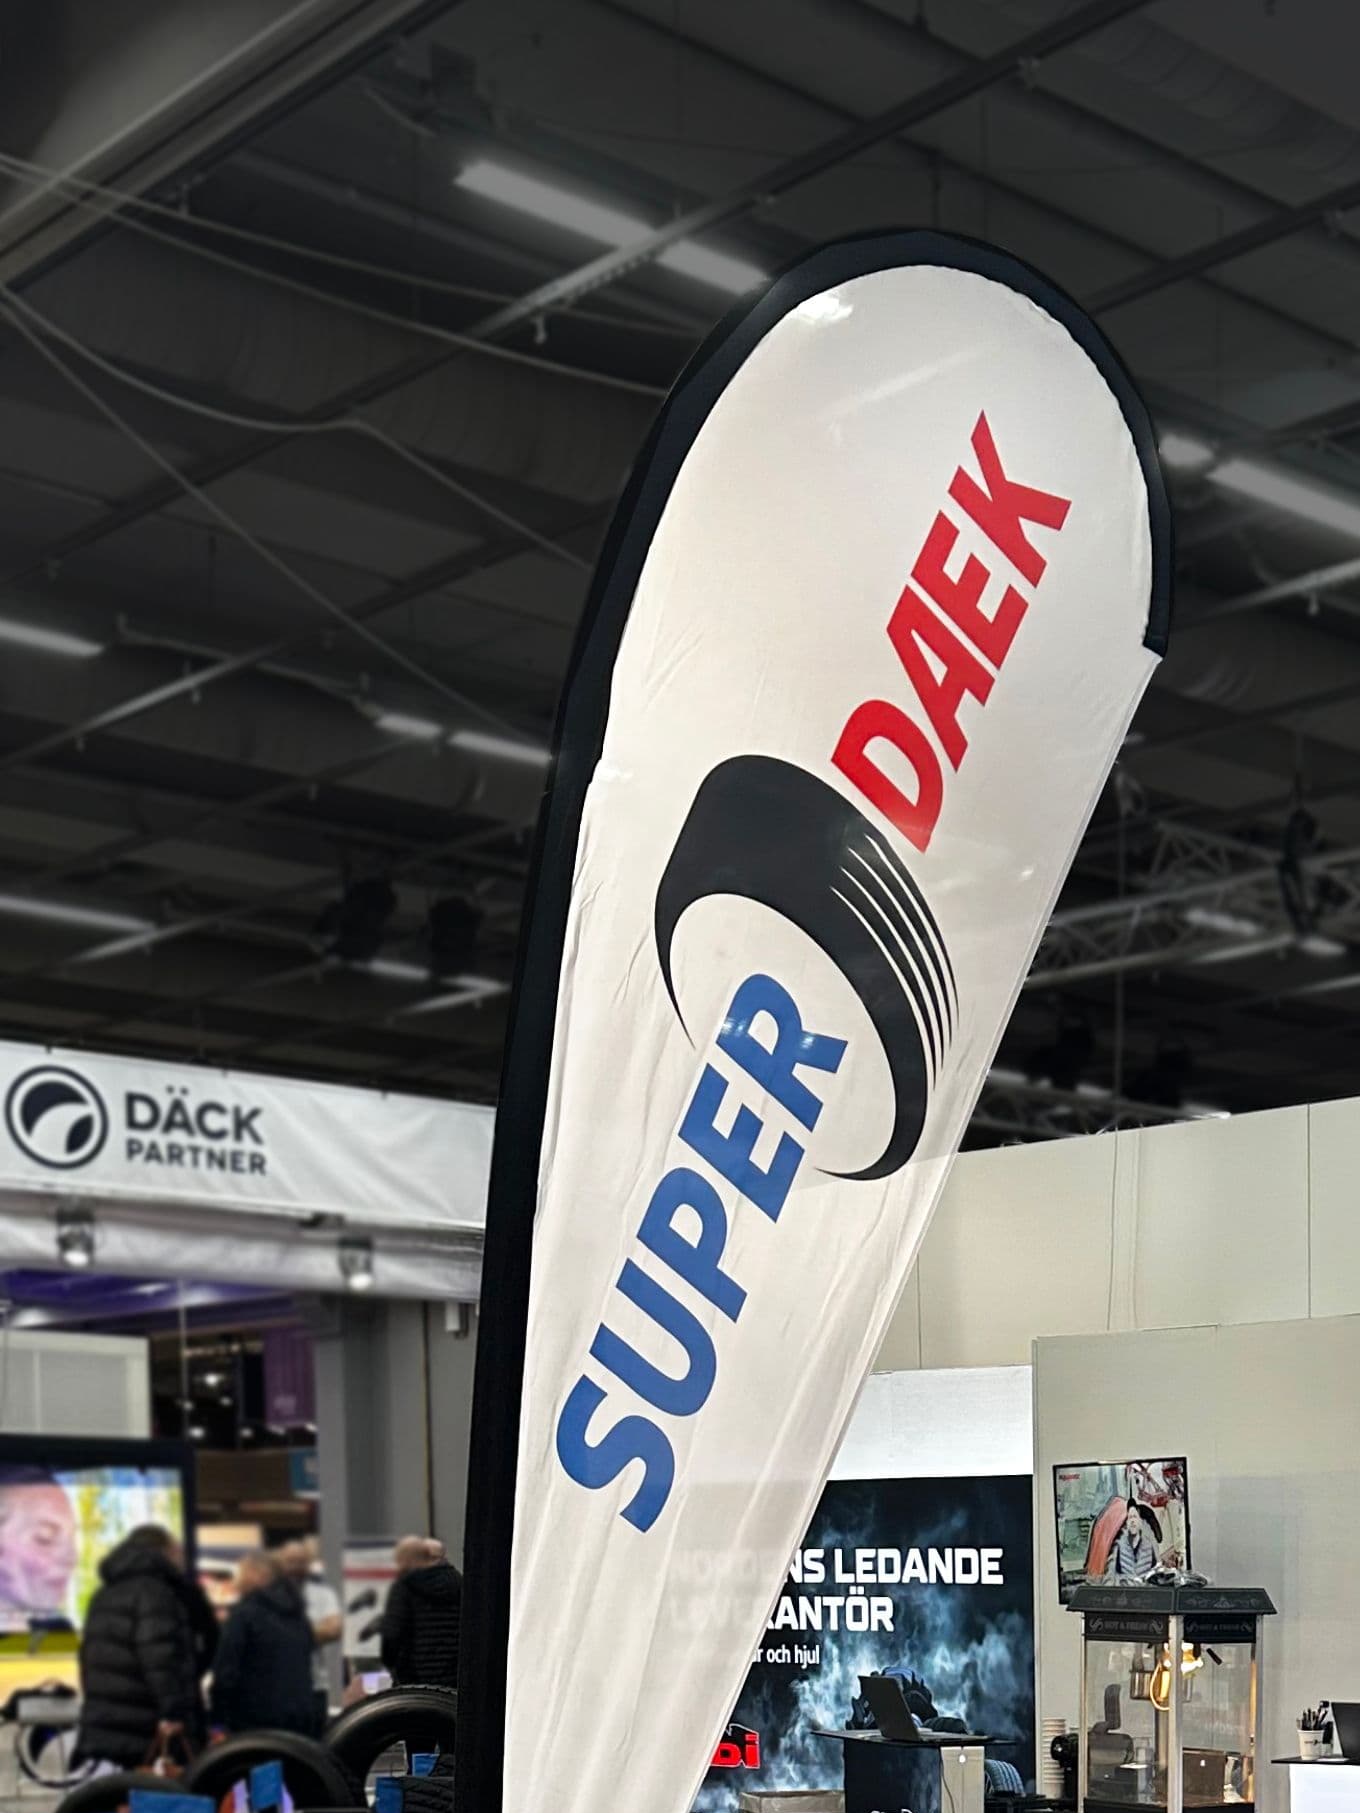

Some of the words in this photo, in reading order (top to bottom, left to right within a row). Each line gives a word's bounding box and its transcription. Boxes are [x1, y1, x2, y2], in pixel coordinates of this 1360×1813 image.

[556, 973, 848, 1533] SUPER
[831, 409, 1071, 854] DAEK
[125, 1084, 263, 1145] DÄCK
[126, 1138, 267, 1176] PARTNER
[834, 1548, 1004, 1585] LEDANDE
[767, 1646, 791, 1664] och
[795, 1645, 820, 1670] hjul
